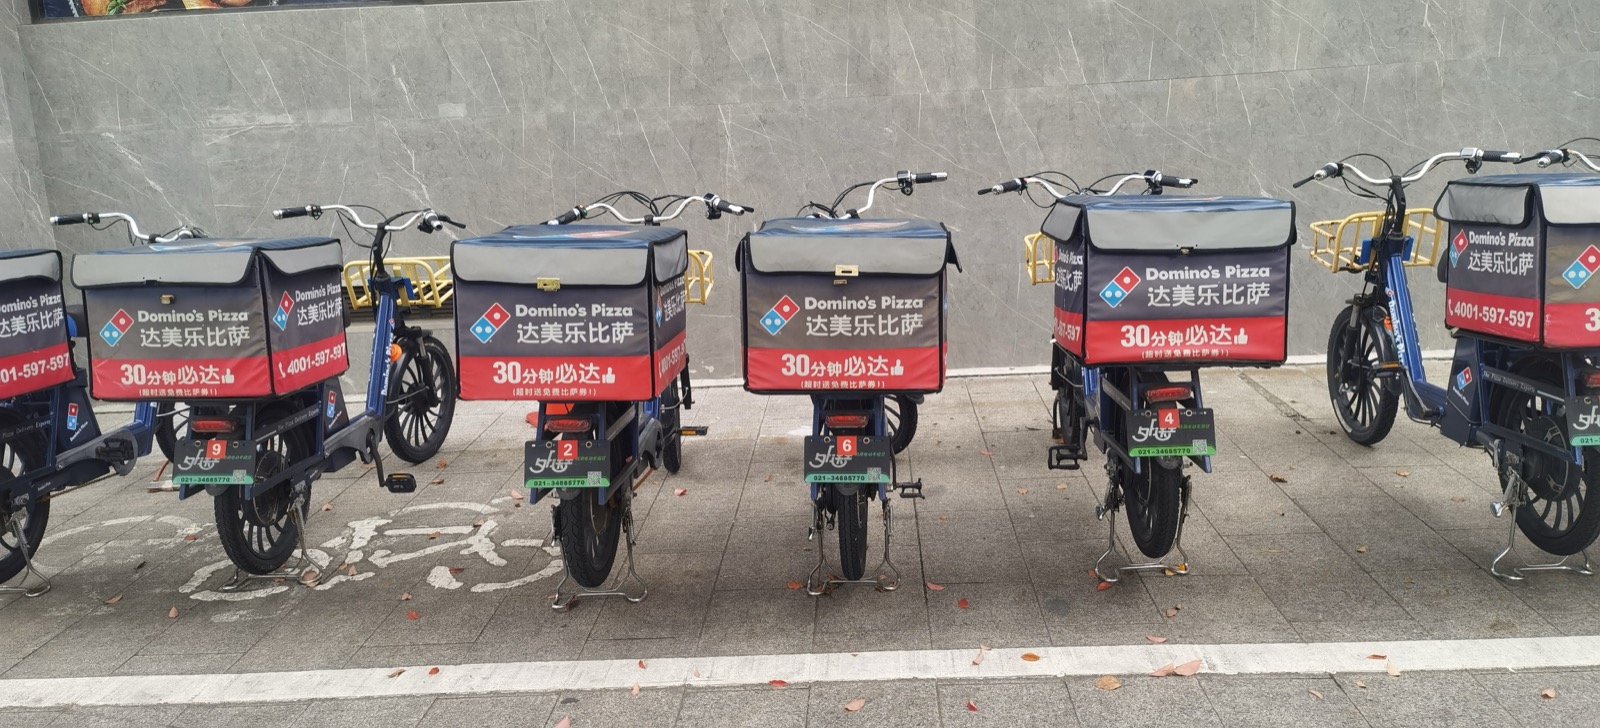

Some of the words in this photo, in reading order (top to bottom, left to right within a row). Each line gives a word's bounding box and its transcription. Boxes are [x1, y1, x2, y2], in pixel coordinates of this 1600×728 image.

[1469, 231, 1506, 247] Domino's
[1508, 232, 1534, 247] Pizza
[1146, 265, 1221, 281] Domino's
[1225, 264, 1270, 279] Pizza
[1467, 249, 1534, 277] 达美乐比萨
[0, 296, 38, 313] omino's
[40, 294, 61, 306] Pizza
[295, 285, 326, 302] Domino's
[327, 283, 341, 295] Pizza
[805, 296, 876, 310] Domino's
[881, 295, 923, 309] Pizza
[1147, 281, 1270, 308] 达美乐比萨
[138, 309, 204, 323] Domino's
[208, 309, 249, 322] Pizza
[297, 297, 342, 326] 达美乐比萨
[515, 303, 587, 317] Domino's
[591, 303, 633, 317] Pizza
[1454, 301, 1534, 328] 4001-597-597
[0, 307, 64, 338] 达美乐比萨
[517, 321, 635, 344] 达美乐比萨
[806, 313, 923, 336] 达美乐比萨
[140, 325, 250, 347] 达美乐比萨
[1120, 323, 1233, 348] 30分钟必达
[287, 342, 345, 375] 4001-597-597
[781, 353, 889, 377] 30分钟必达
[120, 363, 221, 385] 30分钟必达
[493, 361, 601, 384] 30分钟必达
[1164, 412, 1174, 425] 4
[212, 443, 221, 455] 9
[563, 443, 573, 457] 2
[842, 439, 852, 452] 6
